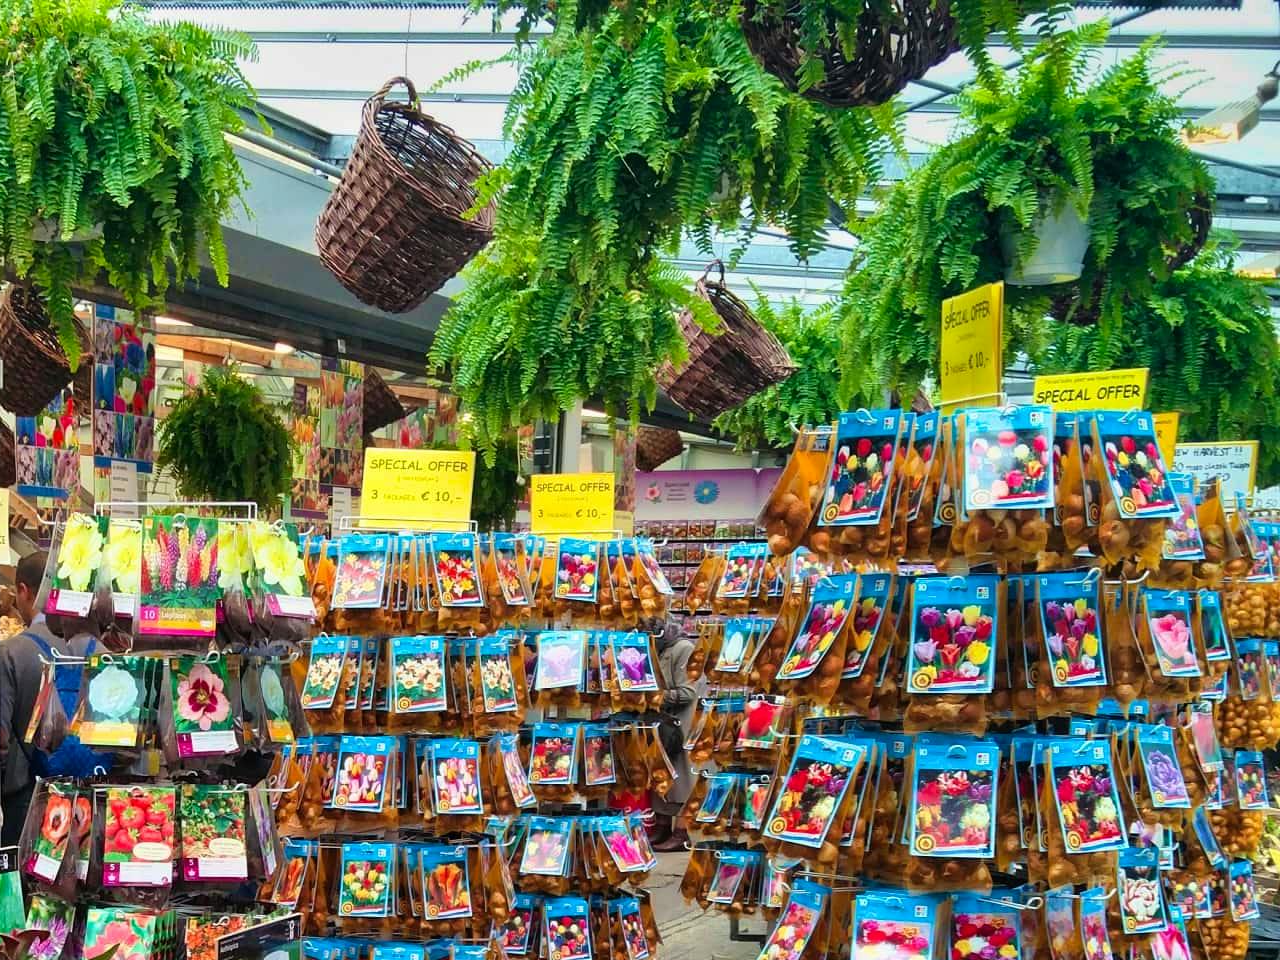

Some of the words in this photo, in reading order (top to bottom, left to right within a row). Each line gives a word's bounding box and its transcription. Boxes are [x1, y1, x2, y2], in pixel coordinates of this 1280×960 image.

[944, 308, 969, 330] SPECIAL
[971, 300, 990, 321] OFFER
[944, 361, 950, 377] 3
[1036, 388, 1091, 404] SPECIAL
[1096, 384, 1141, 400] OFFER
[1193, 446, 1232, 457] HARVEST
[370, 458, 423, 471] SPECIAL
[427, 461, 469, 473] OFFER
[536, 482, 576, 493] SPECIAL
[579, 482, 611, 493] OFFER
[371, 489, 378, 500] 3
[421, 491, 431, 501] €
[537, 509, 544, 518] 3
[575, 509, 583, 518] €
[144, 610, 156, 620] 10
[109, 863, 116, 871] 5
